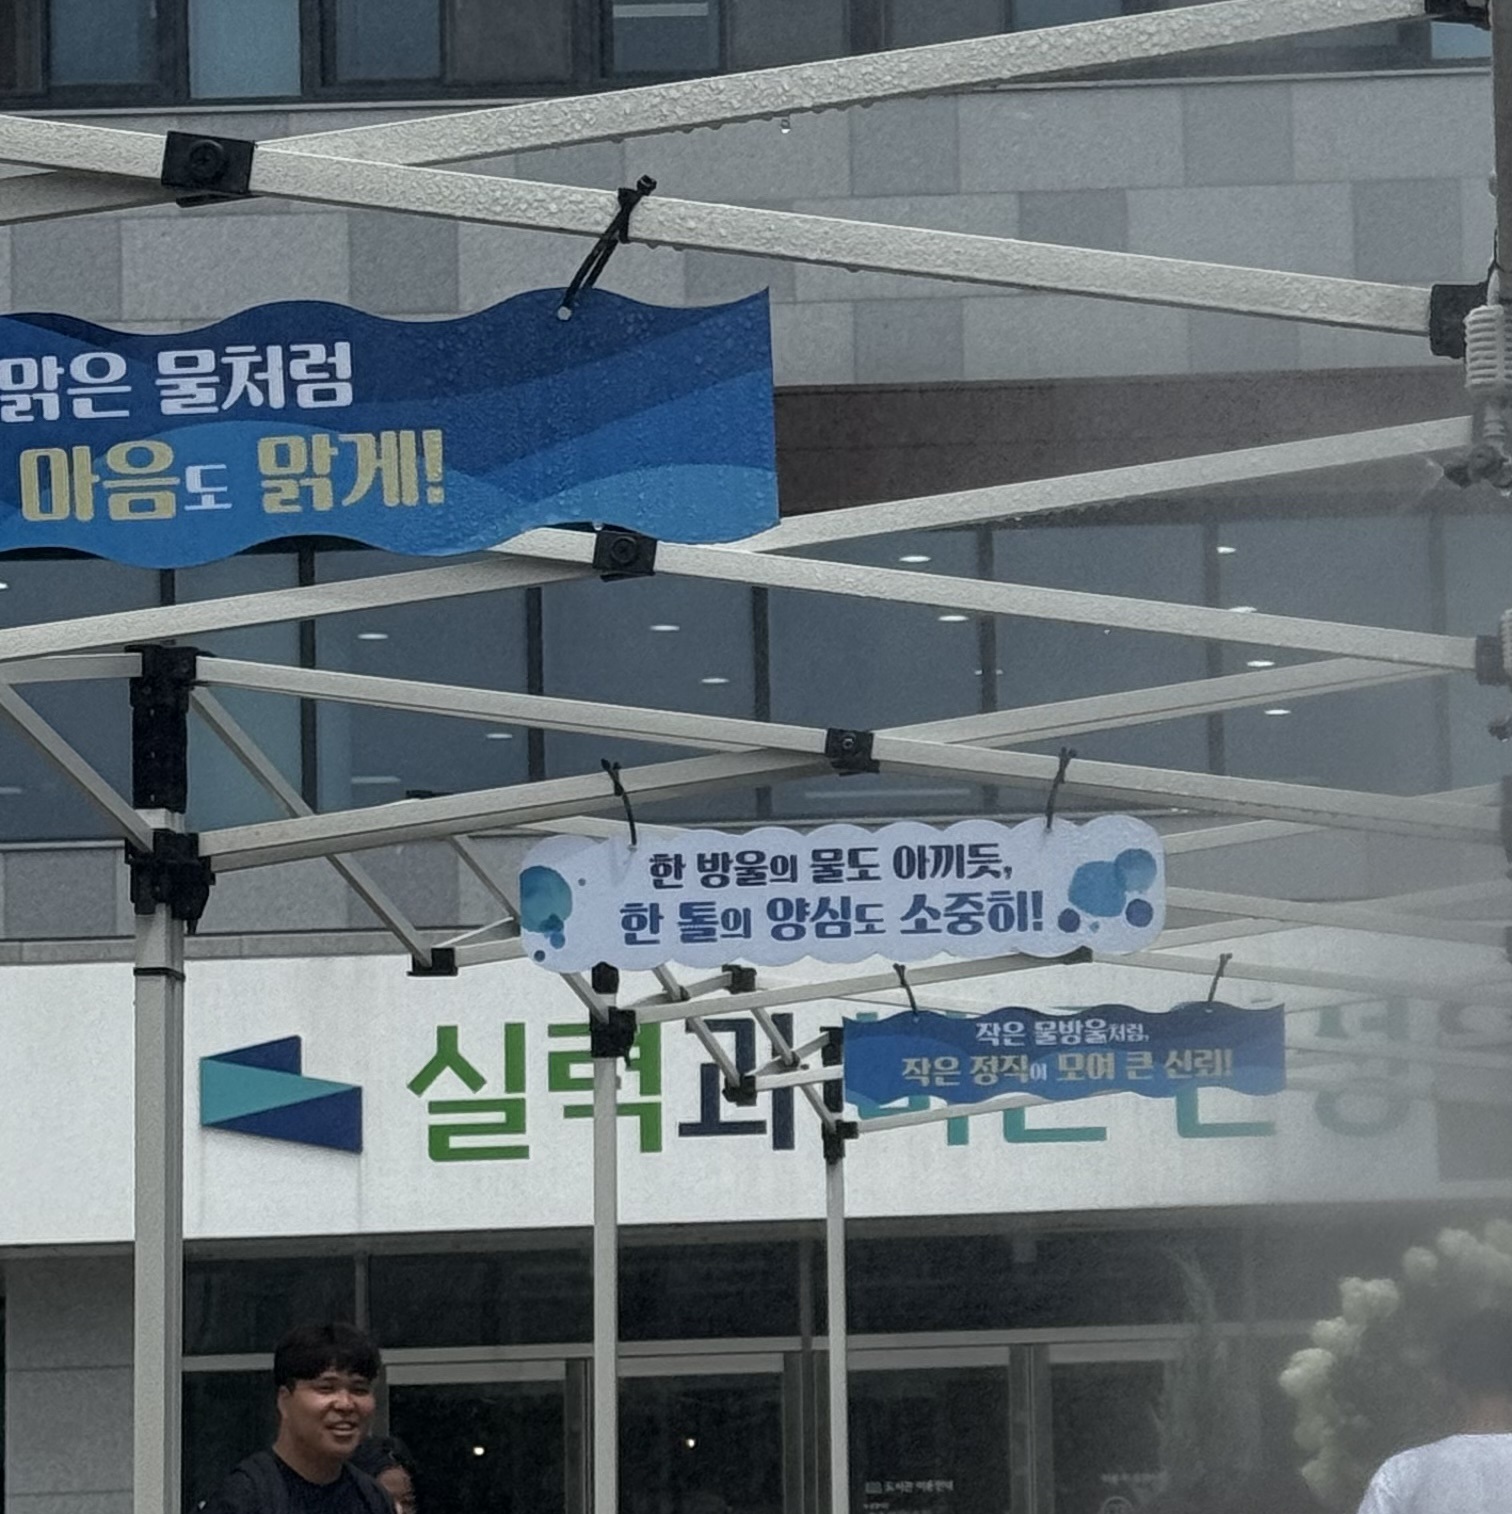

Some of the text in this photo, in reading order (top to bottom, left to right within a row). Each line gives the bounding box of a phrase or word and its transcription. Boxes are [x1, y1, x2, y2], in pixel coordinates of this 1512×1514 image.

[0, 341, 354, 423] 맑은 물처럼
[20, 430, 445, 522] 마음도 맑게!
[649, 842, 1013, 889] 한 방울의 물도 아끼듯,
[619, 890, 1044, 945] 한 톨의 양심도 소중히!
[976, 1021, 1026, 1047] 작은
[407, 1013, 795, 1162] 실력과
[902, 1048, 1233, 1087] 작은 정직이 모여 큰 신뢰!
